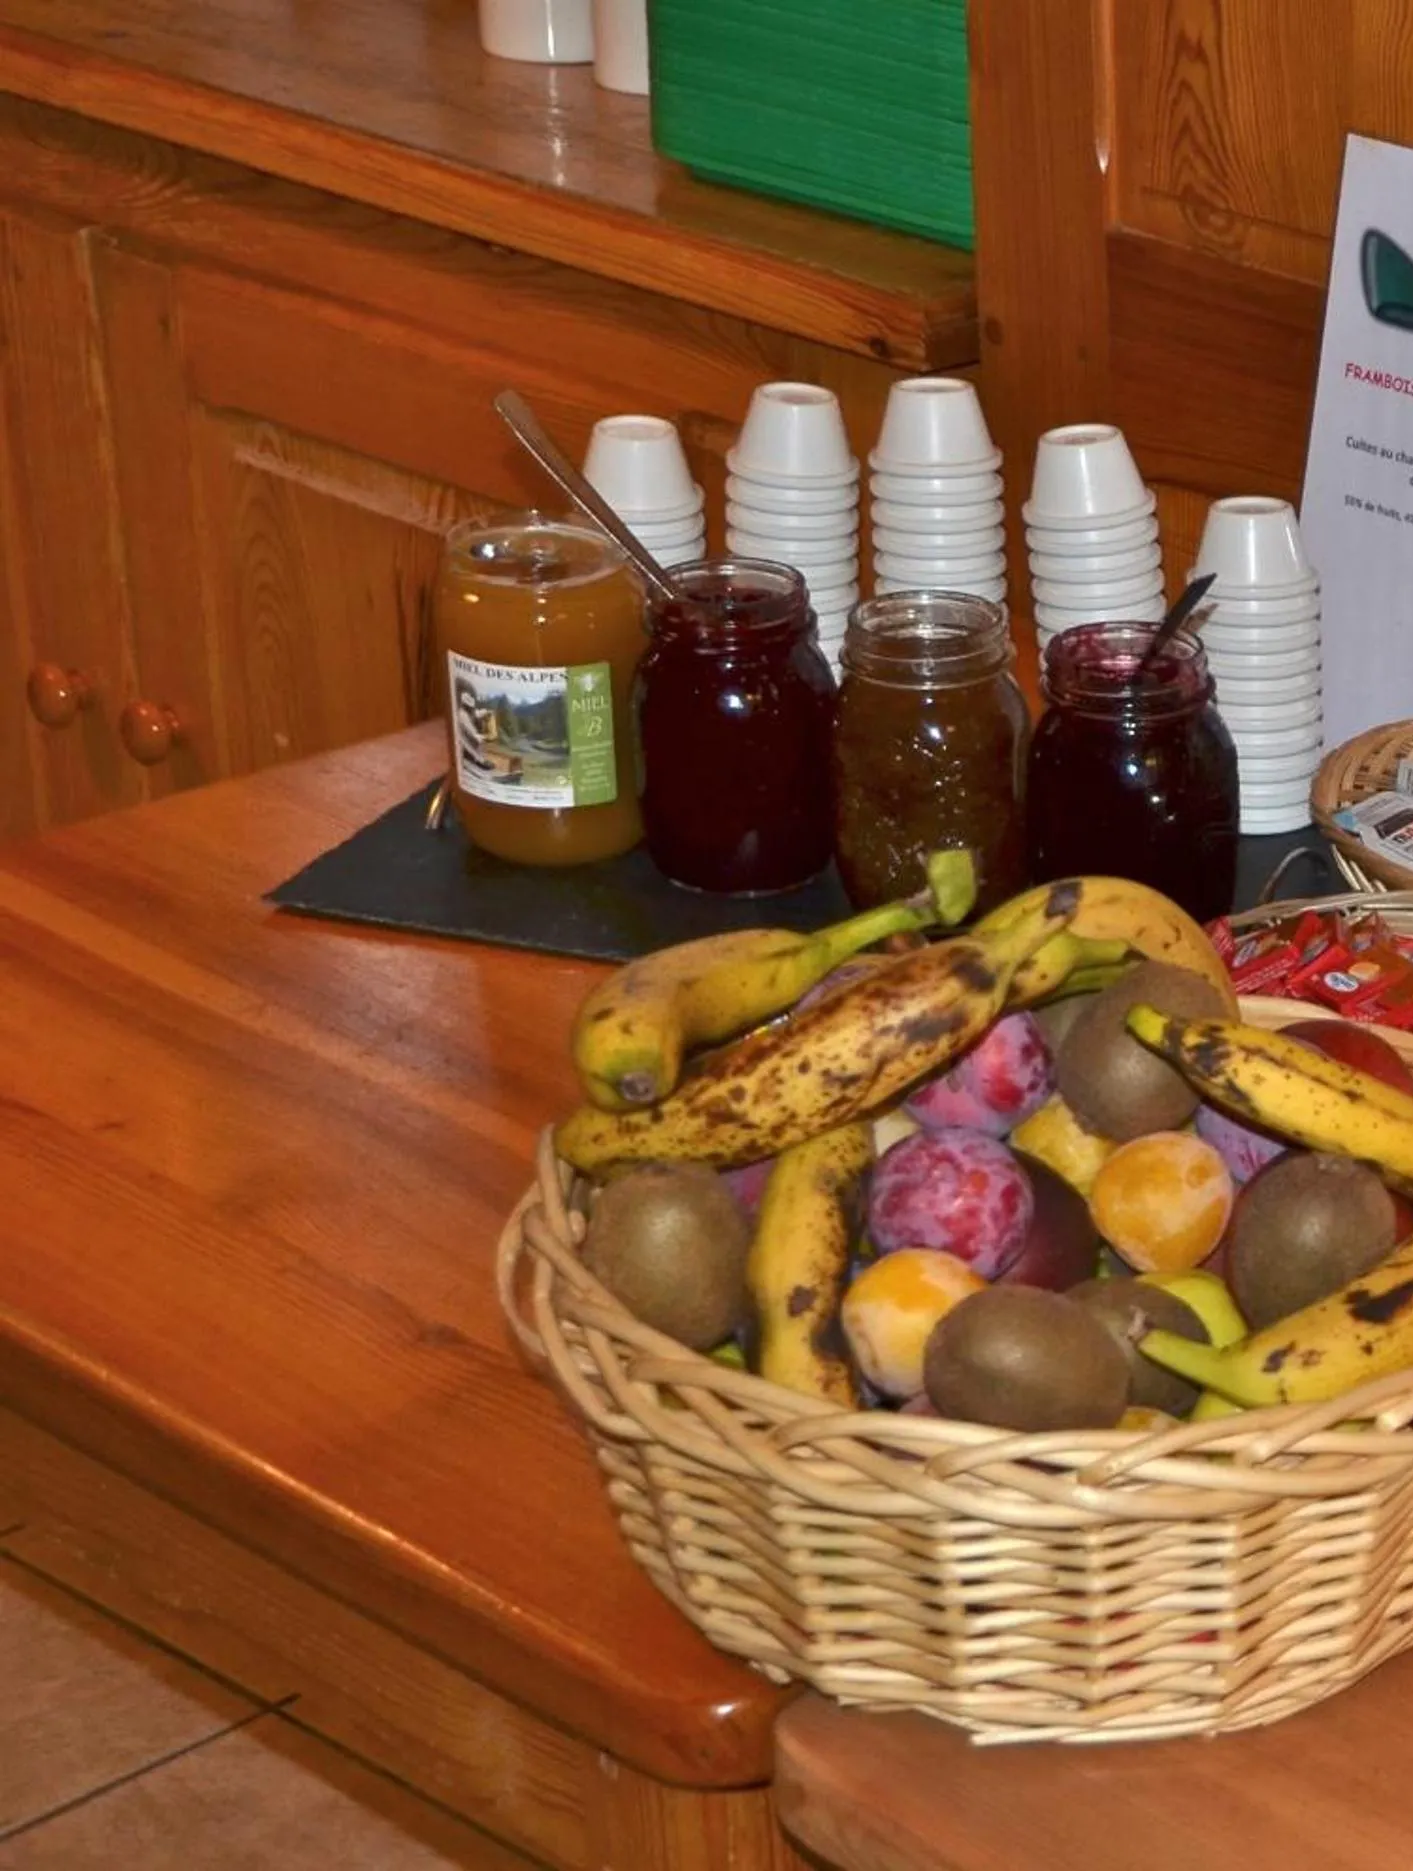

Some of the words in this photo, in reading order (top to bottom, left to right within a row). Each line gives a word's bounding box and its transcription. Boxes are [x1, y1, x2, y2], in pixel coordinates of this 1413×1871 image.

[1345, 436, 1378, 456] Cuites
[1380, 446, 1393, 459] au
[453, 657, 482, 677] MIEL
[485, 667, 514, 682] DES
[517, 671, 569, 684] ALPES
